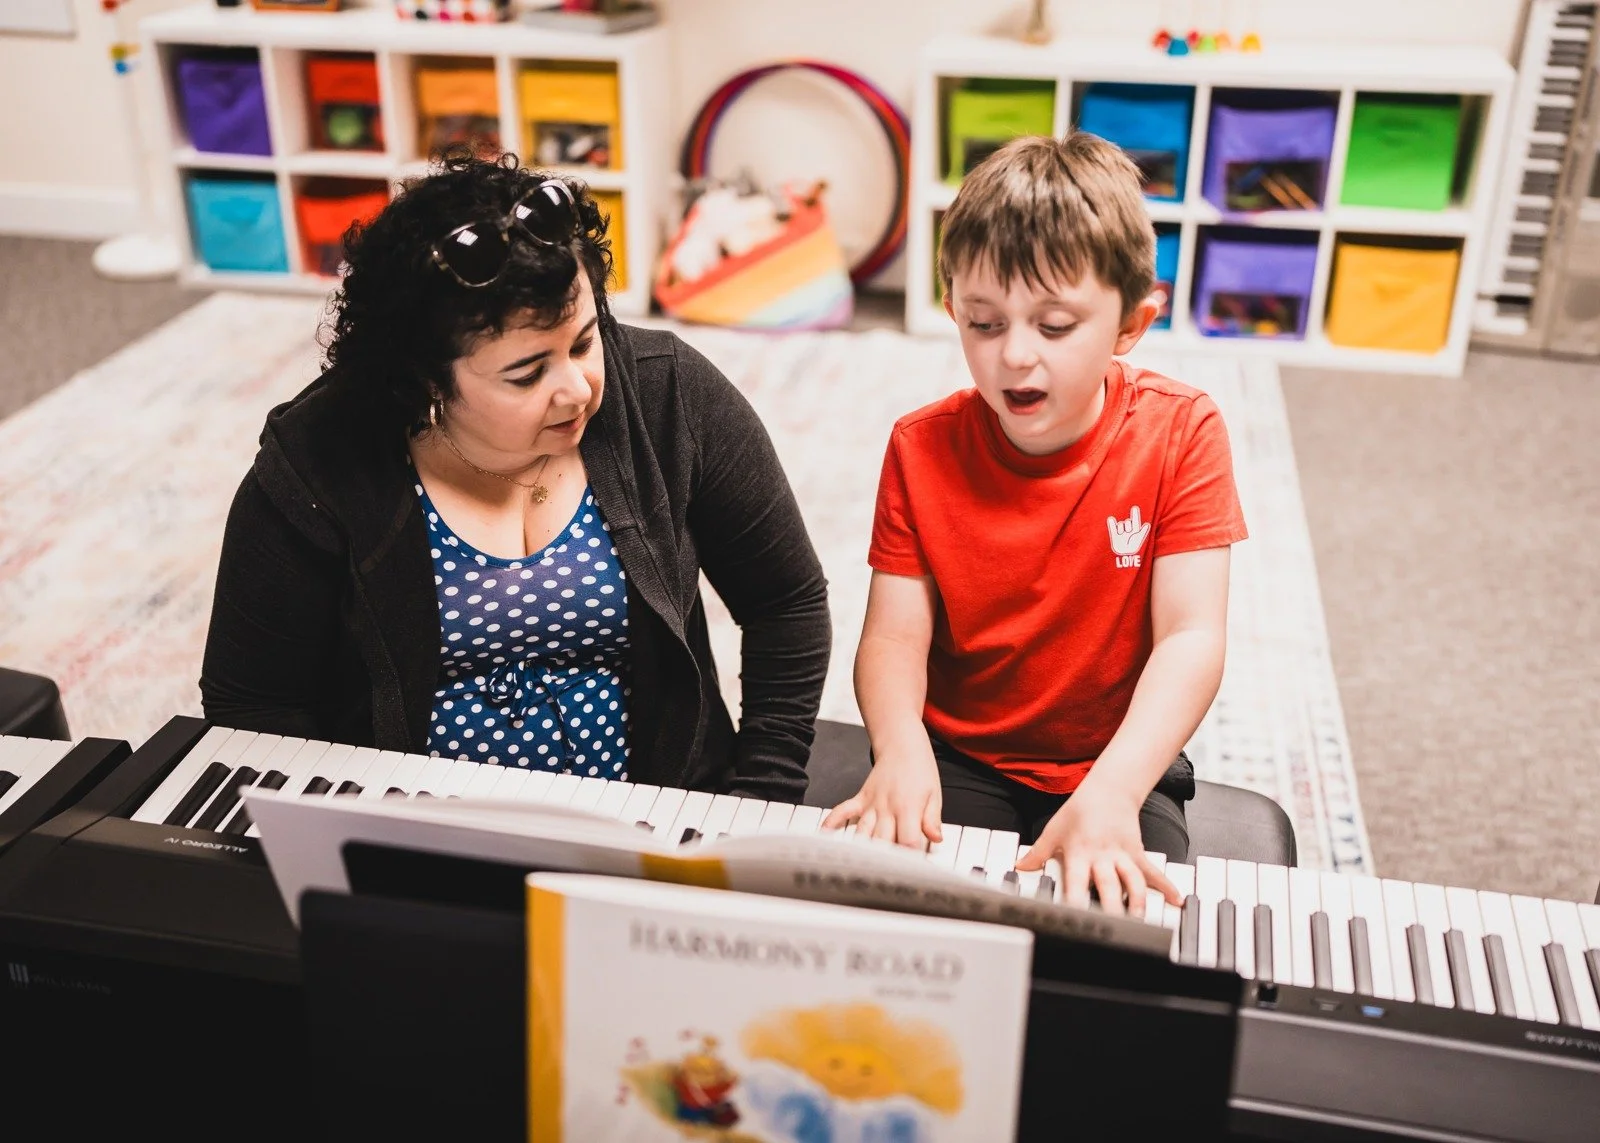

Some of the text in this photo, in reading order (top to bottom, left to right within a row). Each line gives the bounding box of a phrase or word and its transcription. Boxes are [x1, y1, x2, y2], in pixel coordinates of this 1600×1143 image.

[1115, 554, 1141, 568] LOVE
[181, 839, 249, 853] ALLEGRO
[628, 917, 967, 987] HARMONY ROAD
